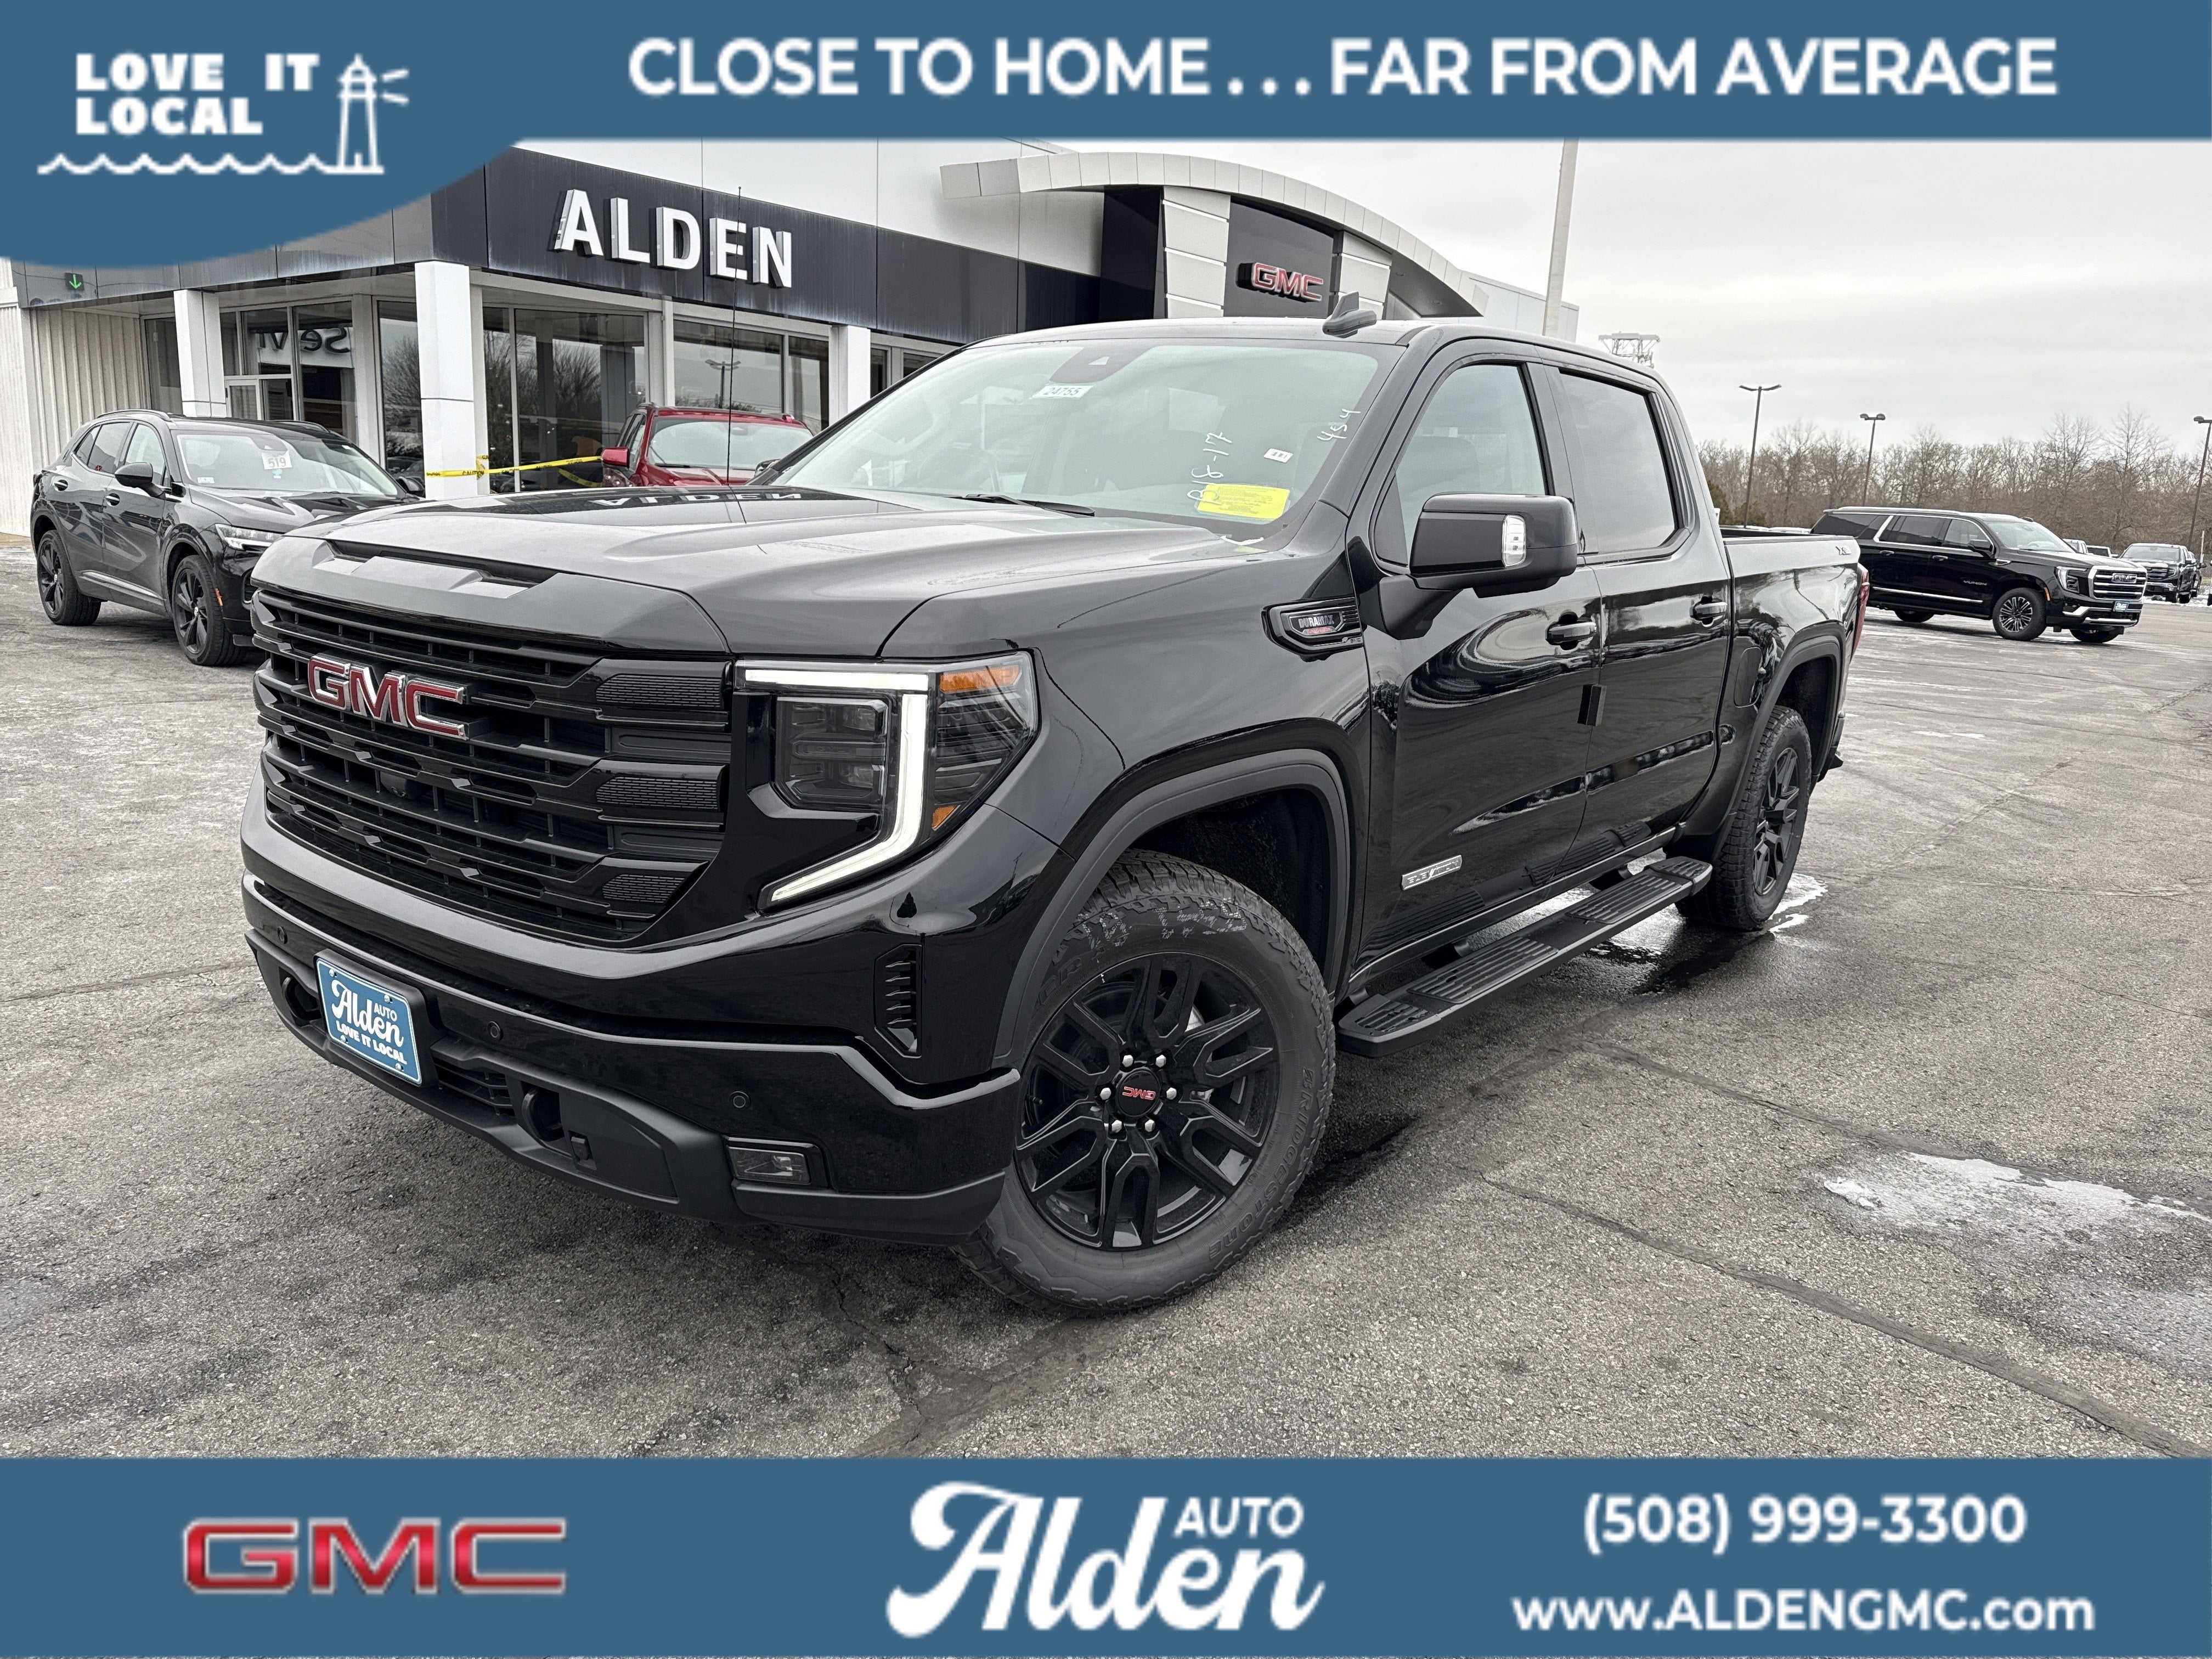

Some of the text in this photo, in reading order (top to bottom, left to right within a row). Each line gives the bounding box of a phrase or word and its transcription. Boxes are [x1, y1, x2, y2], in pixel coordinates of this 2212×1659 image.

[555, 189, 792, 288] ALDEN
[1252, 262, 1324, 302] GMC
[268, 457, 286, 468] 519
[1298, 614, 1335, 629] DURAMAX
[307, 654, 467, 741] GMC
[331, 979, 404, 1048] Alden
[374, 1003, 397, 1022] AUTO
[336, 1020, 408, 1065] LOVE IT LOCAL
[1122, 1086, 1156, 1101] GMC
